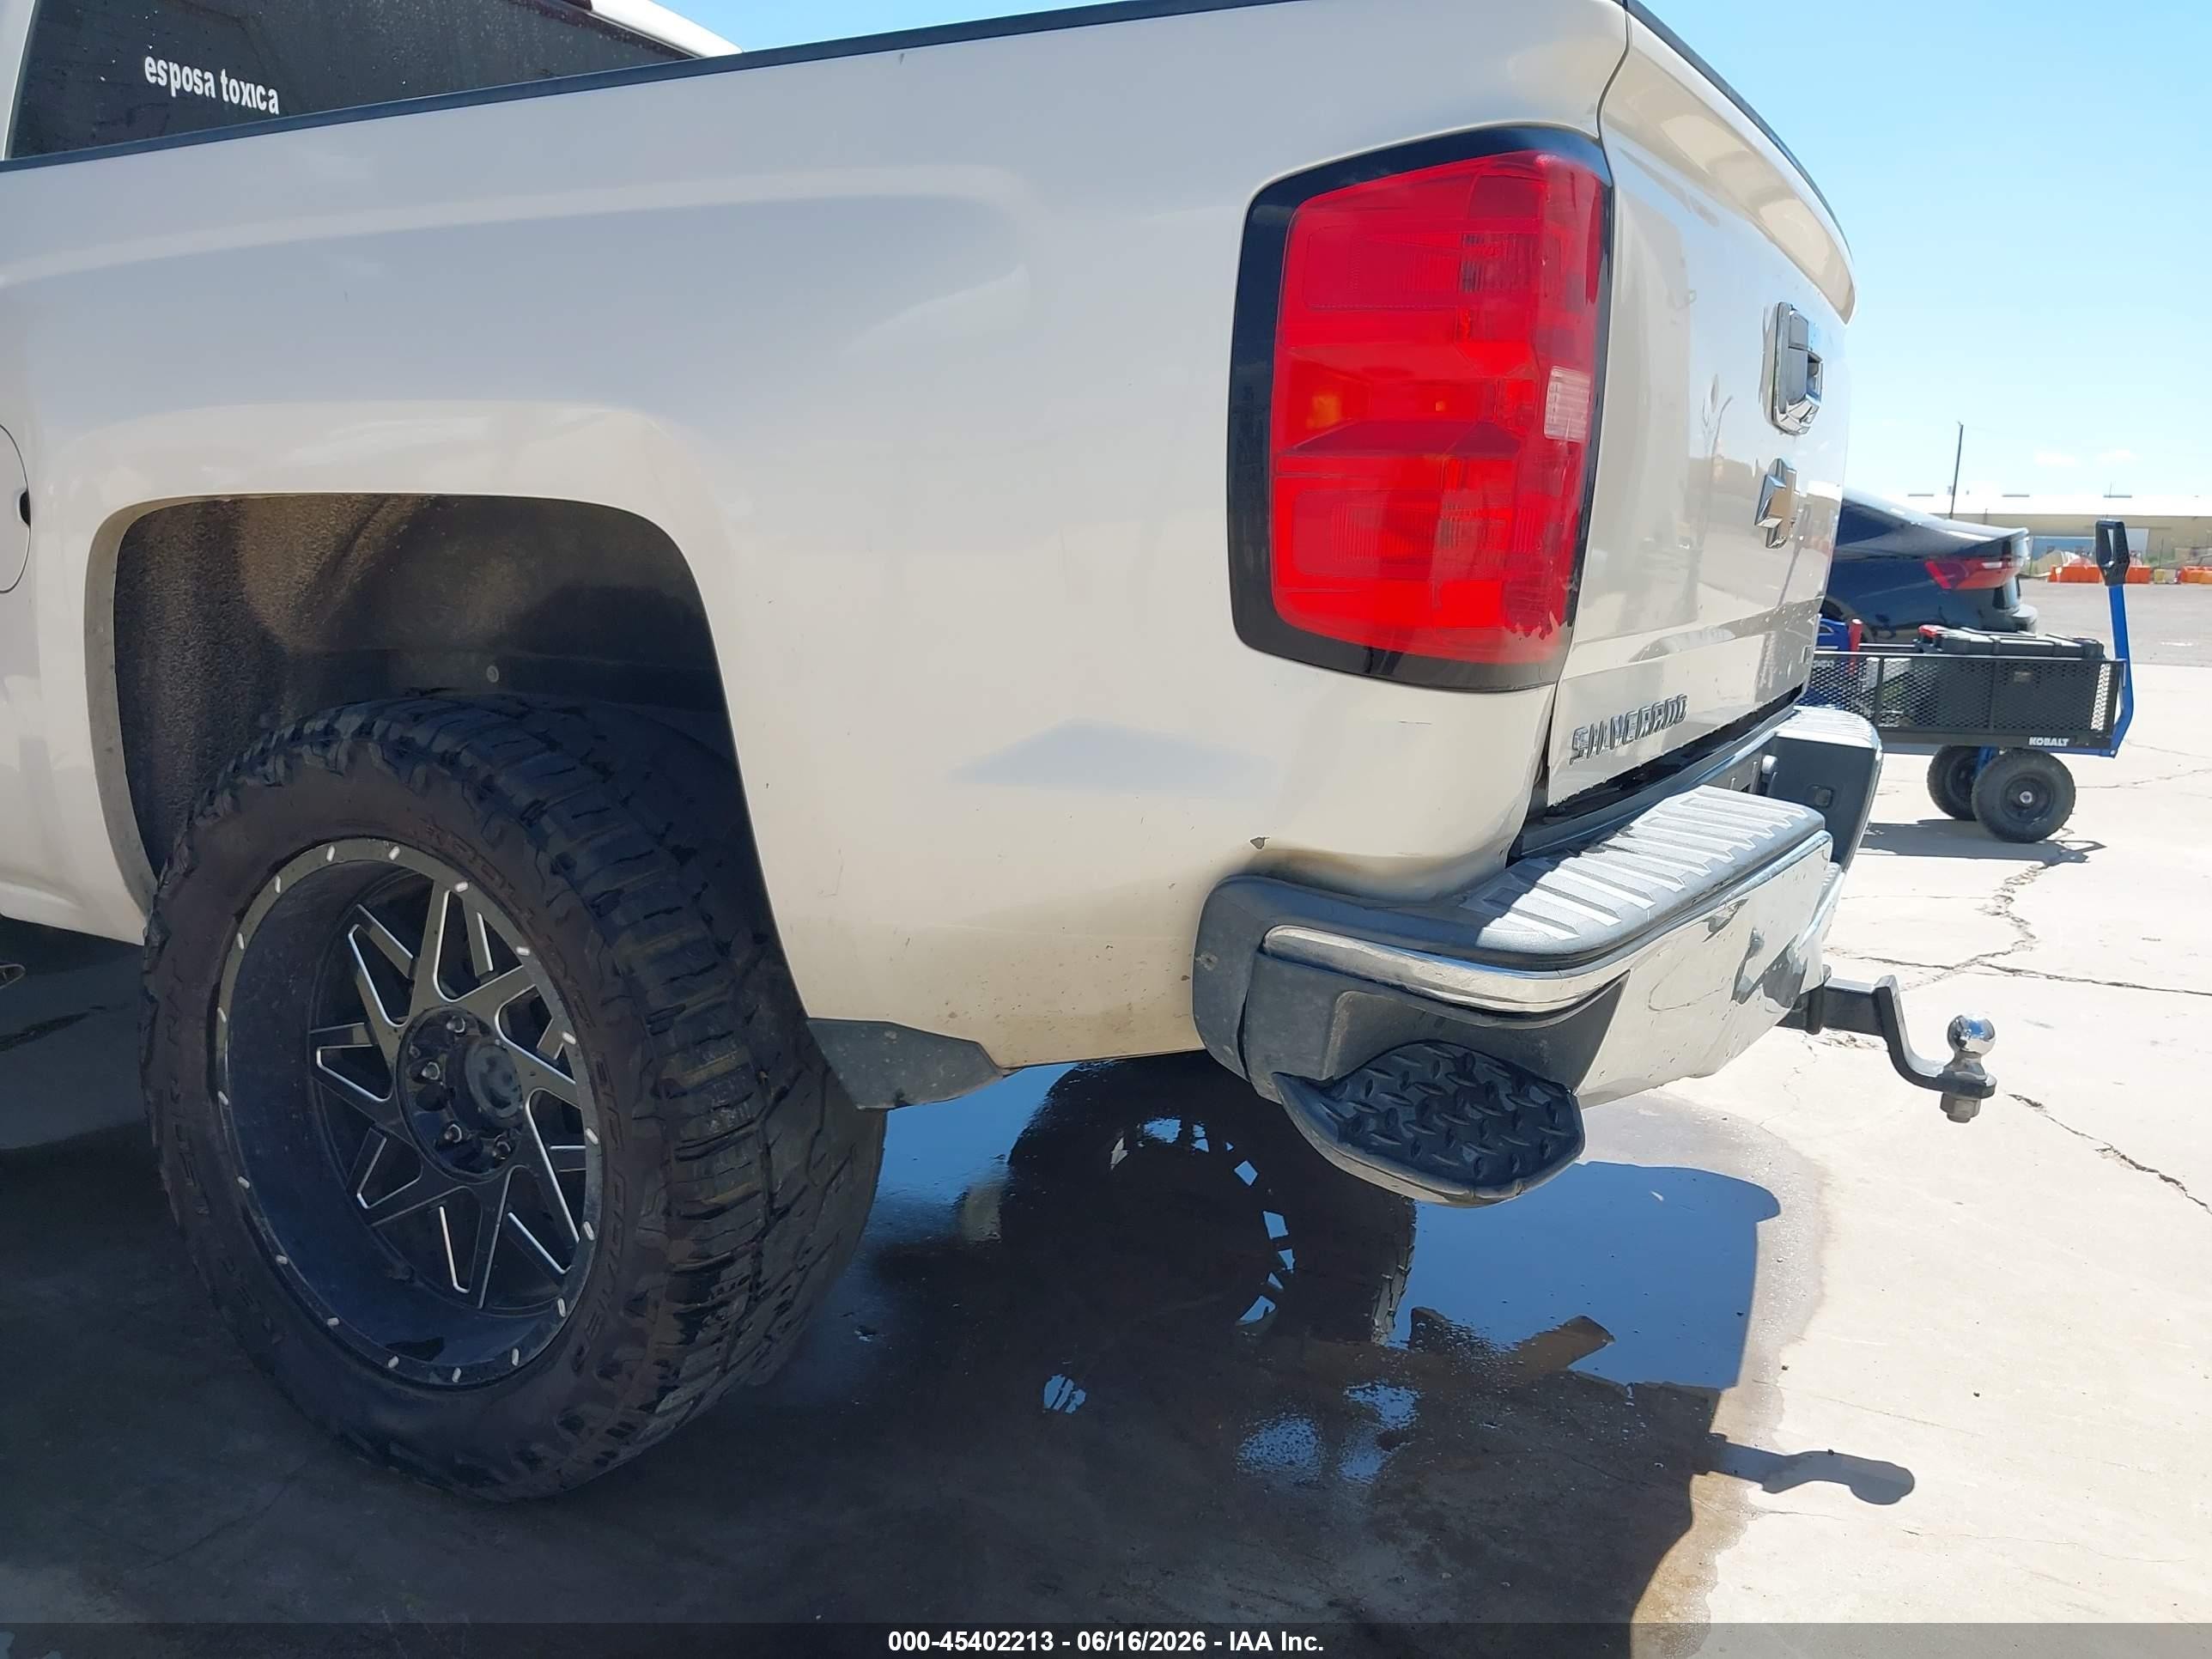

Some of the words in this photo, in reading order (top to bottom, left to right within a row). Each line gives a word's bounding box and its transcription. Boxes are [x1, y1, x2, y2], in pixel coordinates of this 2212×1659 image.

[144, 56, 216, 98] esposa
[1569, 693, 1689, 765] SILVERADO
[2028, 736, 2069, 746] KOBALT
